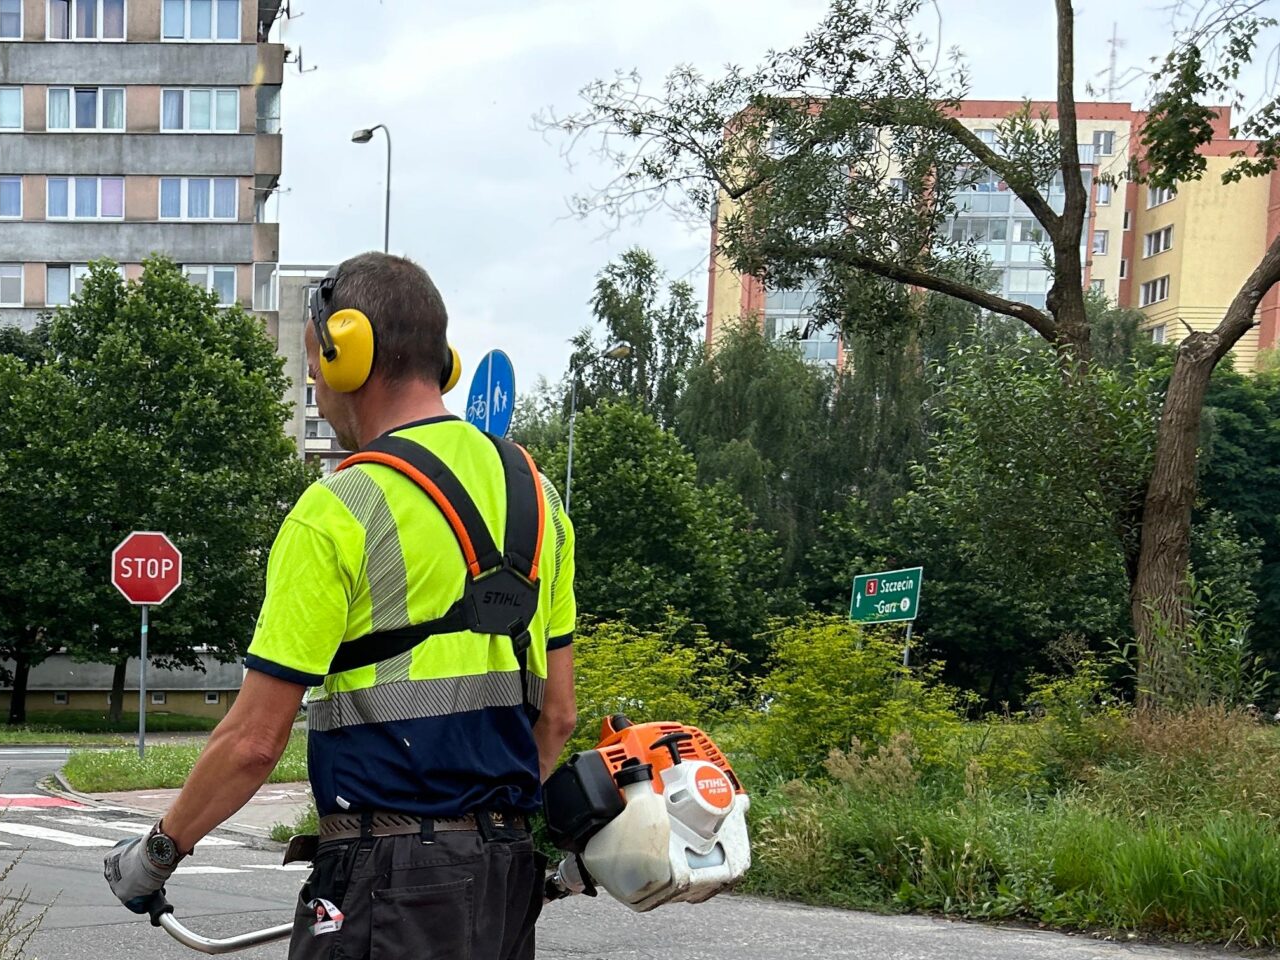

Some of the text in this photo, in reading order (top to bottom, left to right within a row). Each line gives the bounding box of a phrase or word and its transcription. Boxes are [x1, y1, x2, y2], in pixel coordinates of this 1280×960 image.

[120, 557, 174, 579] STOP
[868, 576, 914, 594] 3 Szczecin
[483, 591, 521, 607] STIHL
[877, 600, 897, 614] Garz
[698, 777, 727, 789] STIHL
